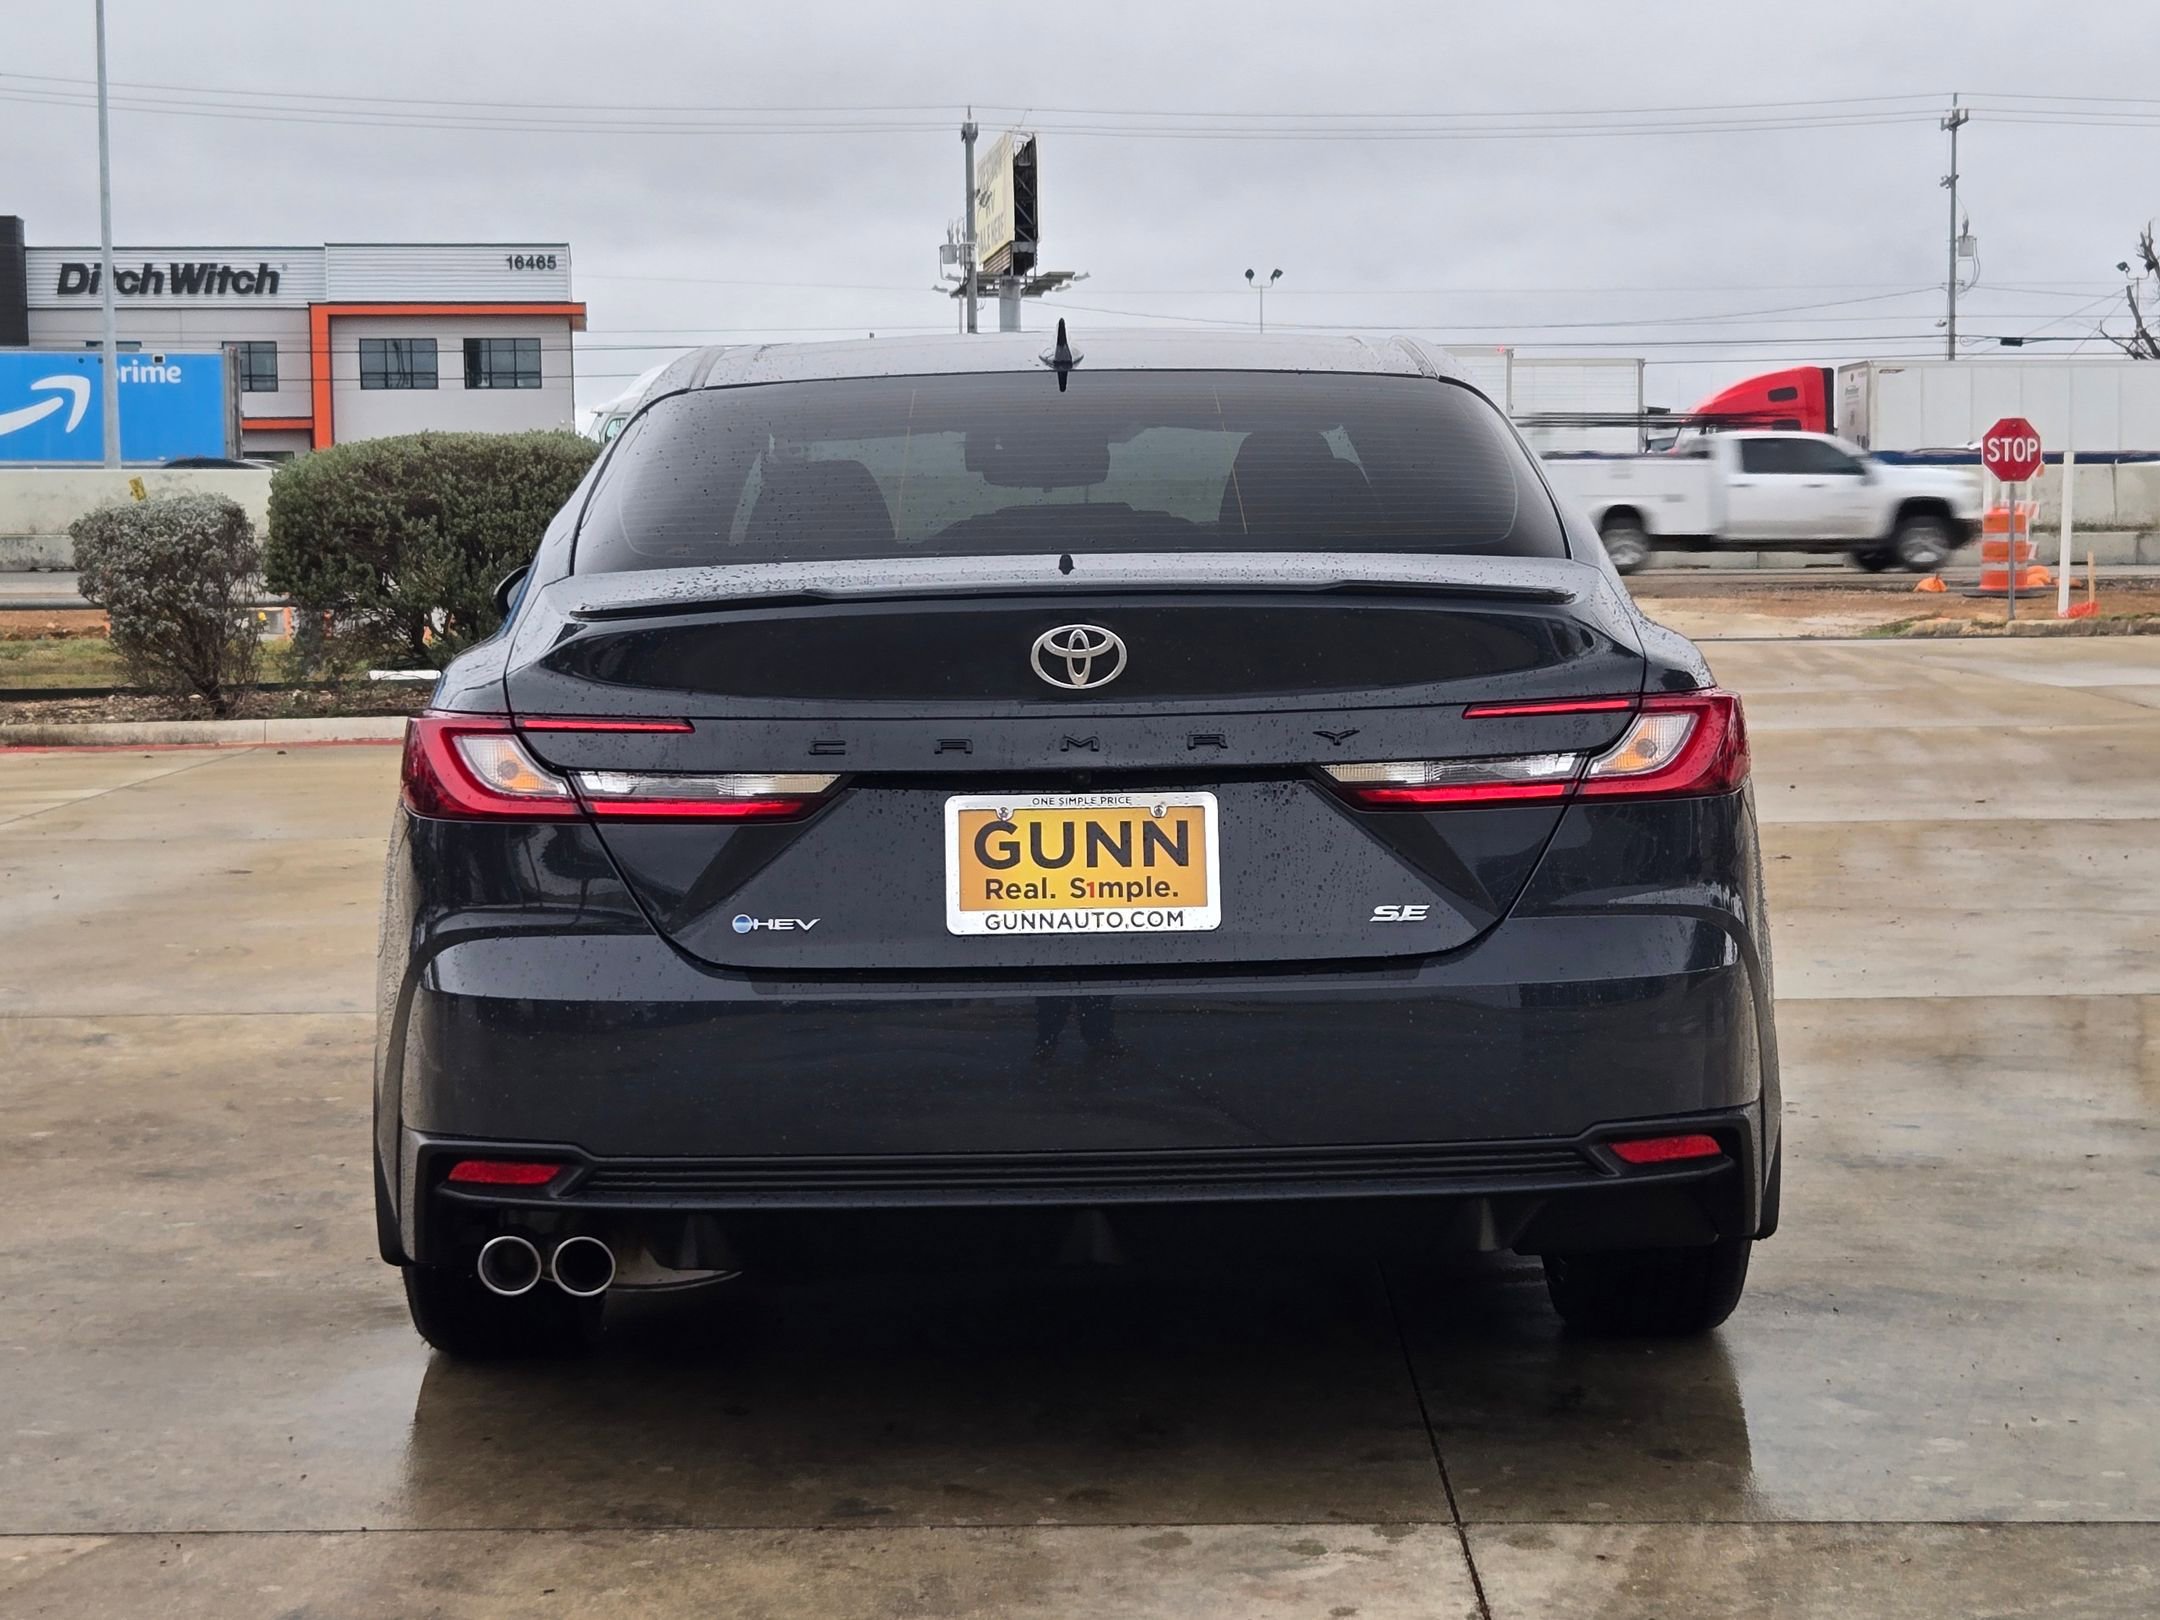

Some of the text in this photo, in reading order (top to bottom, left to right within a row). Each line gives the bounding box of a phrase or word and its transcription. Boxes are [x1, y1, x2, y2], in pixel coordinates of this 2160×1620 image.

[506, 254, 557, 271] 16465
[170, 263, 281, 295] Witch
[115, 359, 182, 384] rime
[1986, 437, 2039, 464] STOP
[808, 729, 1361, 756] CAMRY
[1032, 796, 1132, 806] ONE SIMPLE PRICE
[974, 820, 1189, 870] GUNN
[985, 877, 1056, 900] Real.
[753, 918, 821, 931] HEV
[985, 911, 1184, 931] GUNNAUTO.COM
[1369, 905, 1431, 921] SE
